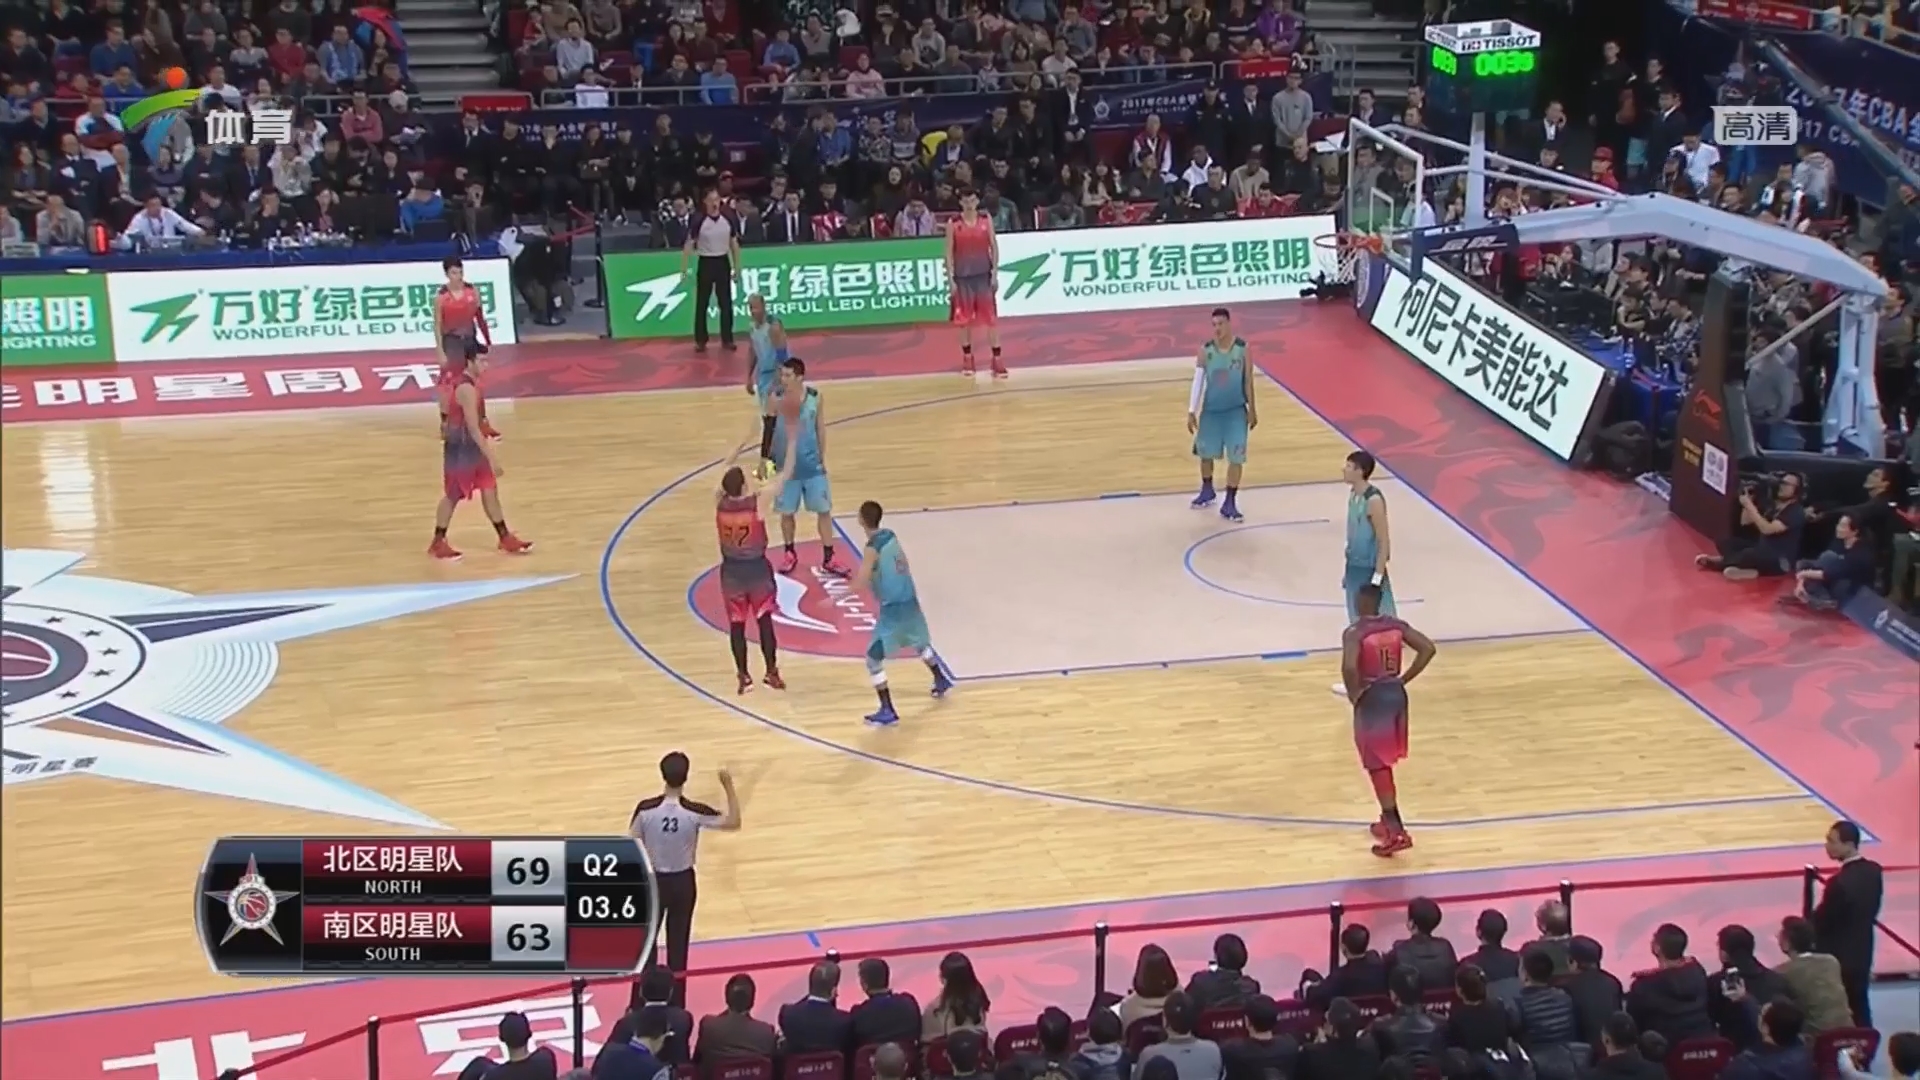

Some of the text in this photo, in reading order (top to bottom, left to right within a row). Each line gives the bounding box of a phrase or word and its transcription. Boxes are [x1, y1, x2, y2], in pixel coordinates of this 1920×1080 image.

[1482, 34, 1537, 50] TISSOT
[1061, 237, 1312, 283] 万好绿色照明
[730, 258, 951, 303] 好绿色照明
[1063, 281, 1181, 297] WONDERFUL
[1187, 277, 1222, 290] LED
[829, 300, 866, 314] LED
[213, 322, 350, 341] WONDERFUL
[357, 321, 396, 336] LED
[1395, 271, 1570, 432] 柯尼卡美能达
[2, 363, 440, 409] 明星周末
[662, 816, 679, 833] 23
